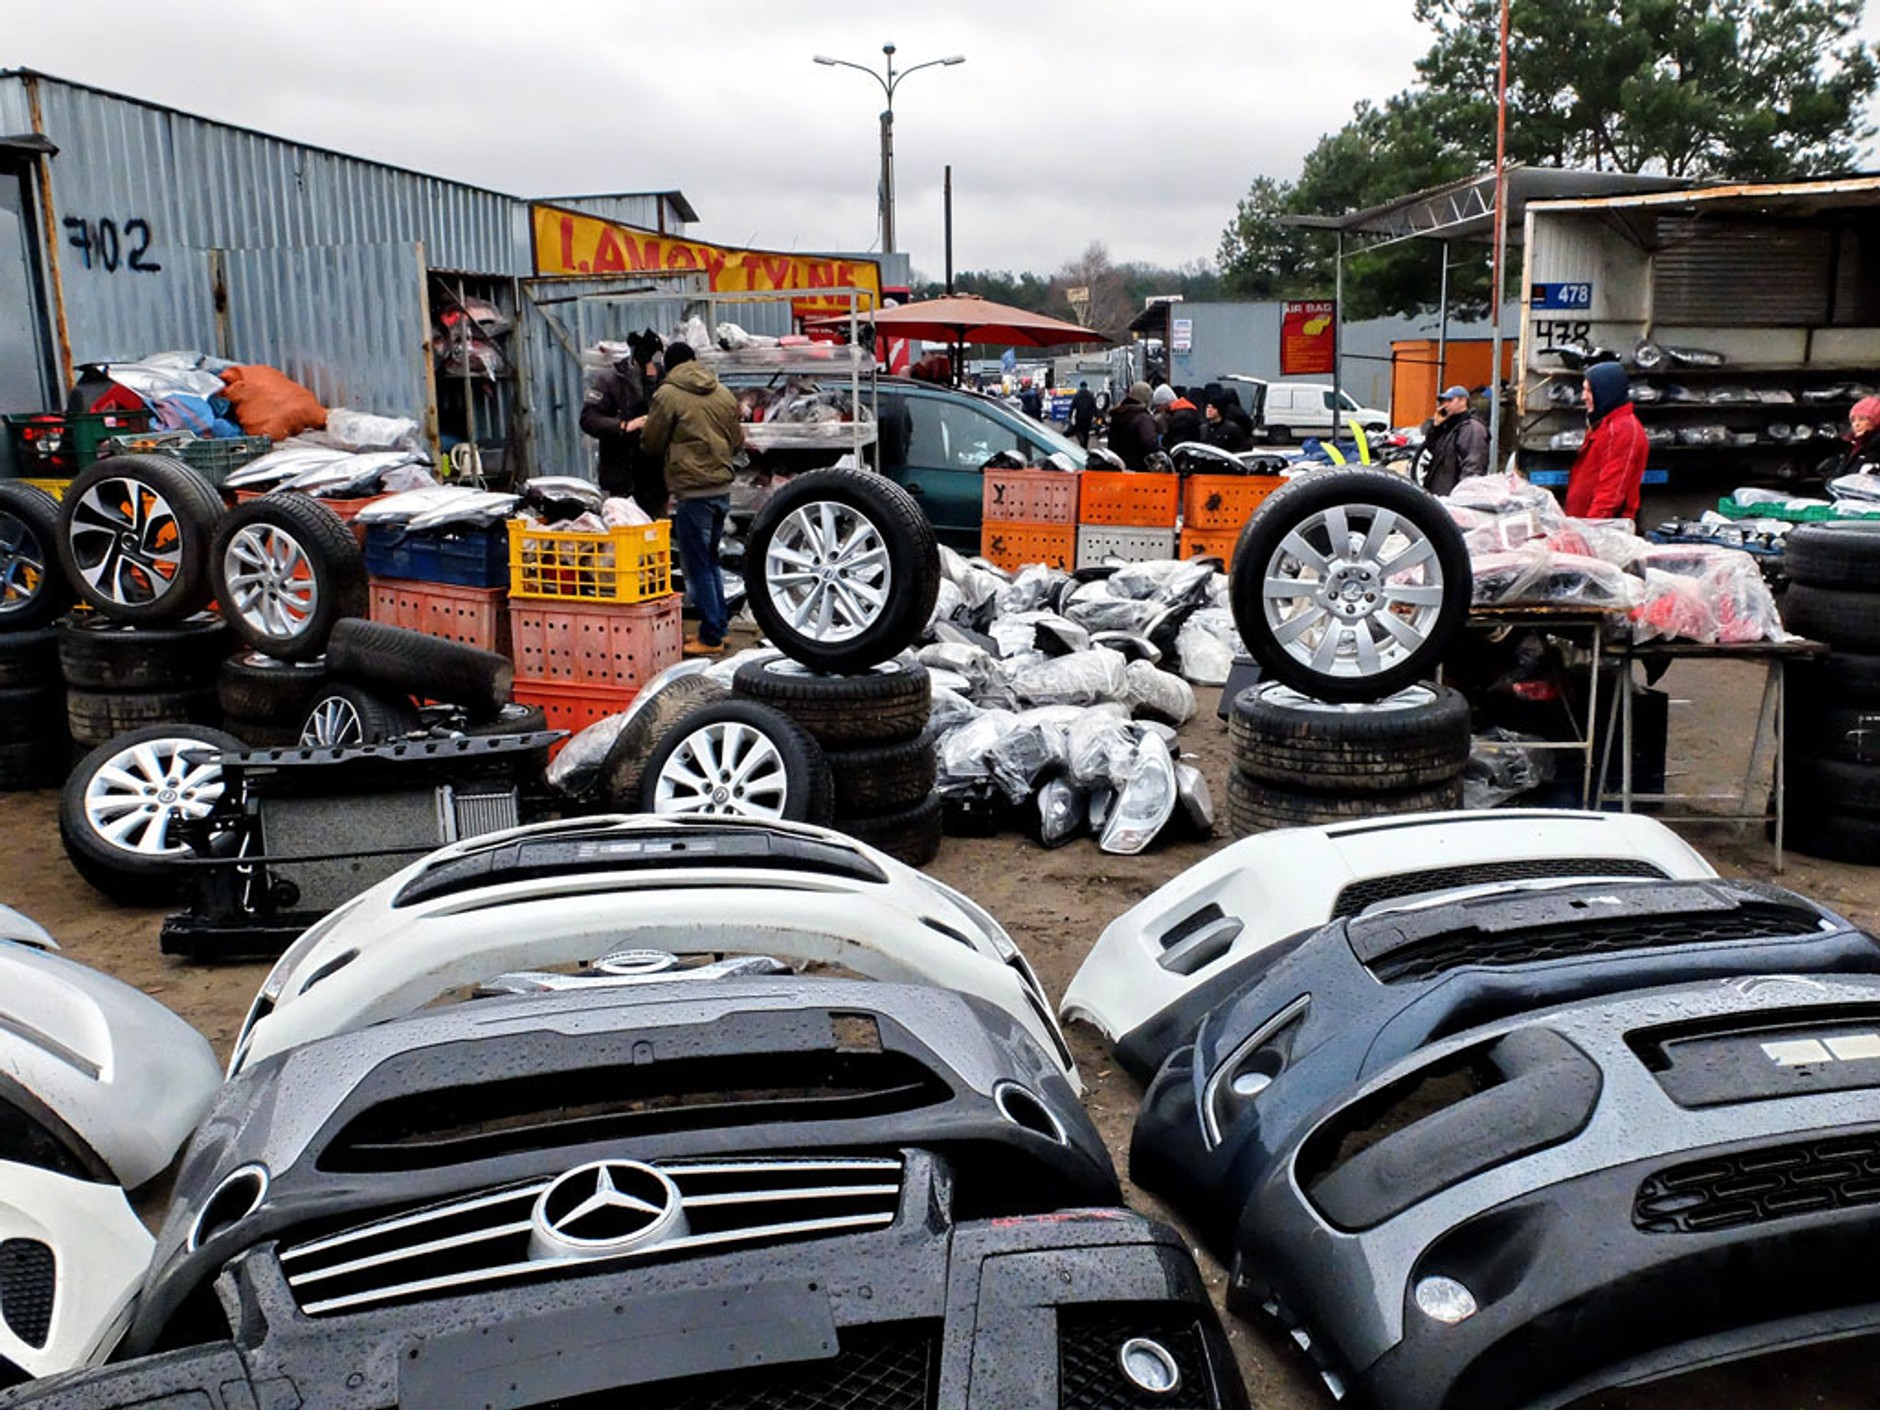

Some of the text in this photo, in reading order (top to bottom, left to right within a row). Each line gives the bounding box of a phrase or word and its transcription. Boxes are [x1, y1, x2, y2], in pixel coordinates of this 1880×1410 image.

[63, 217, 161, 272] 702
[1559, 285, 1588, 302] 478
[1306, 303, 1332, 313] BAG
[1537, 320, 1590, 351] 478
